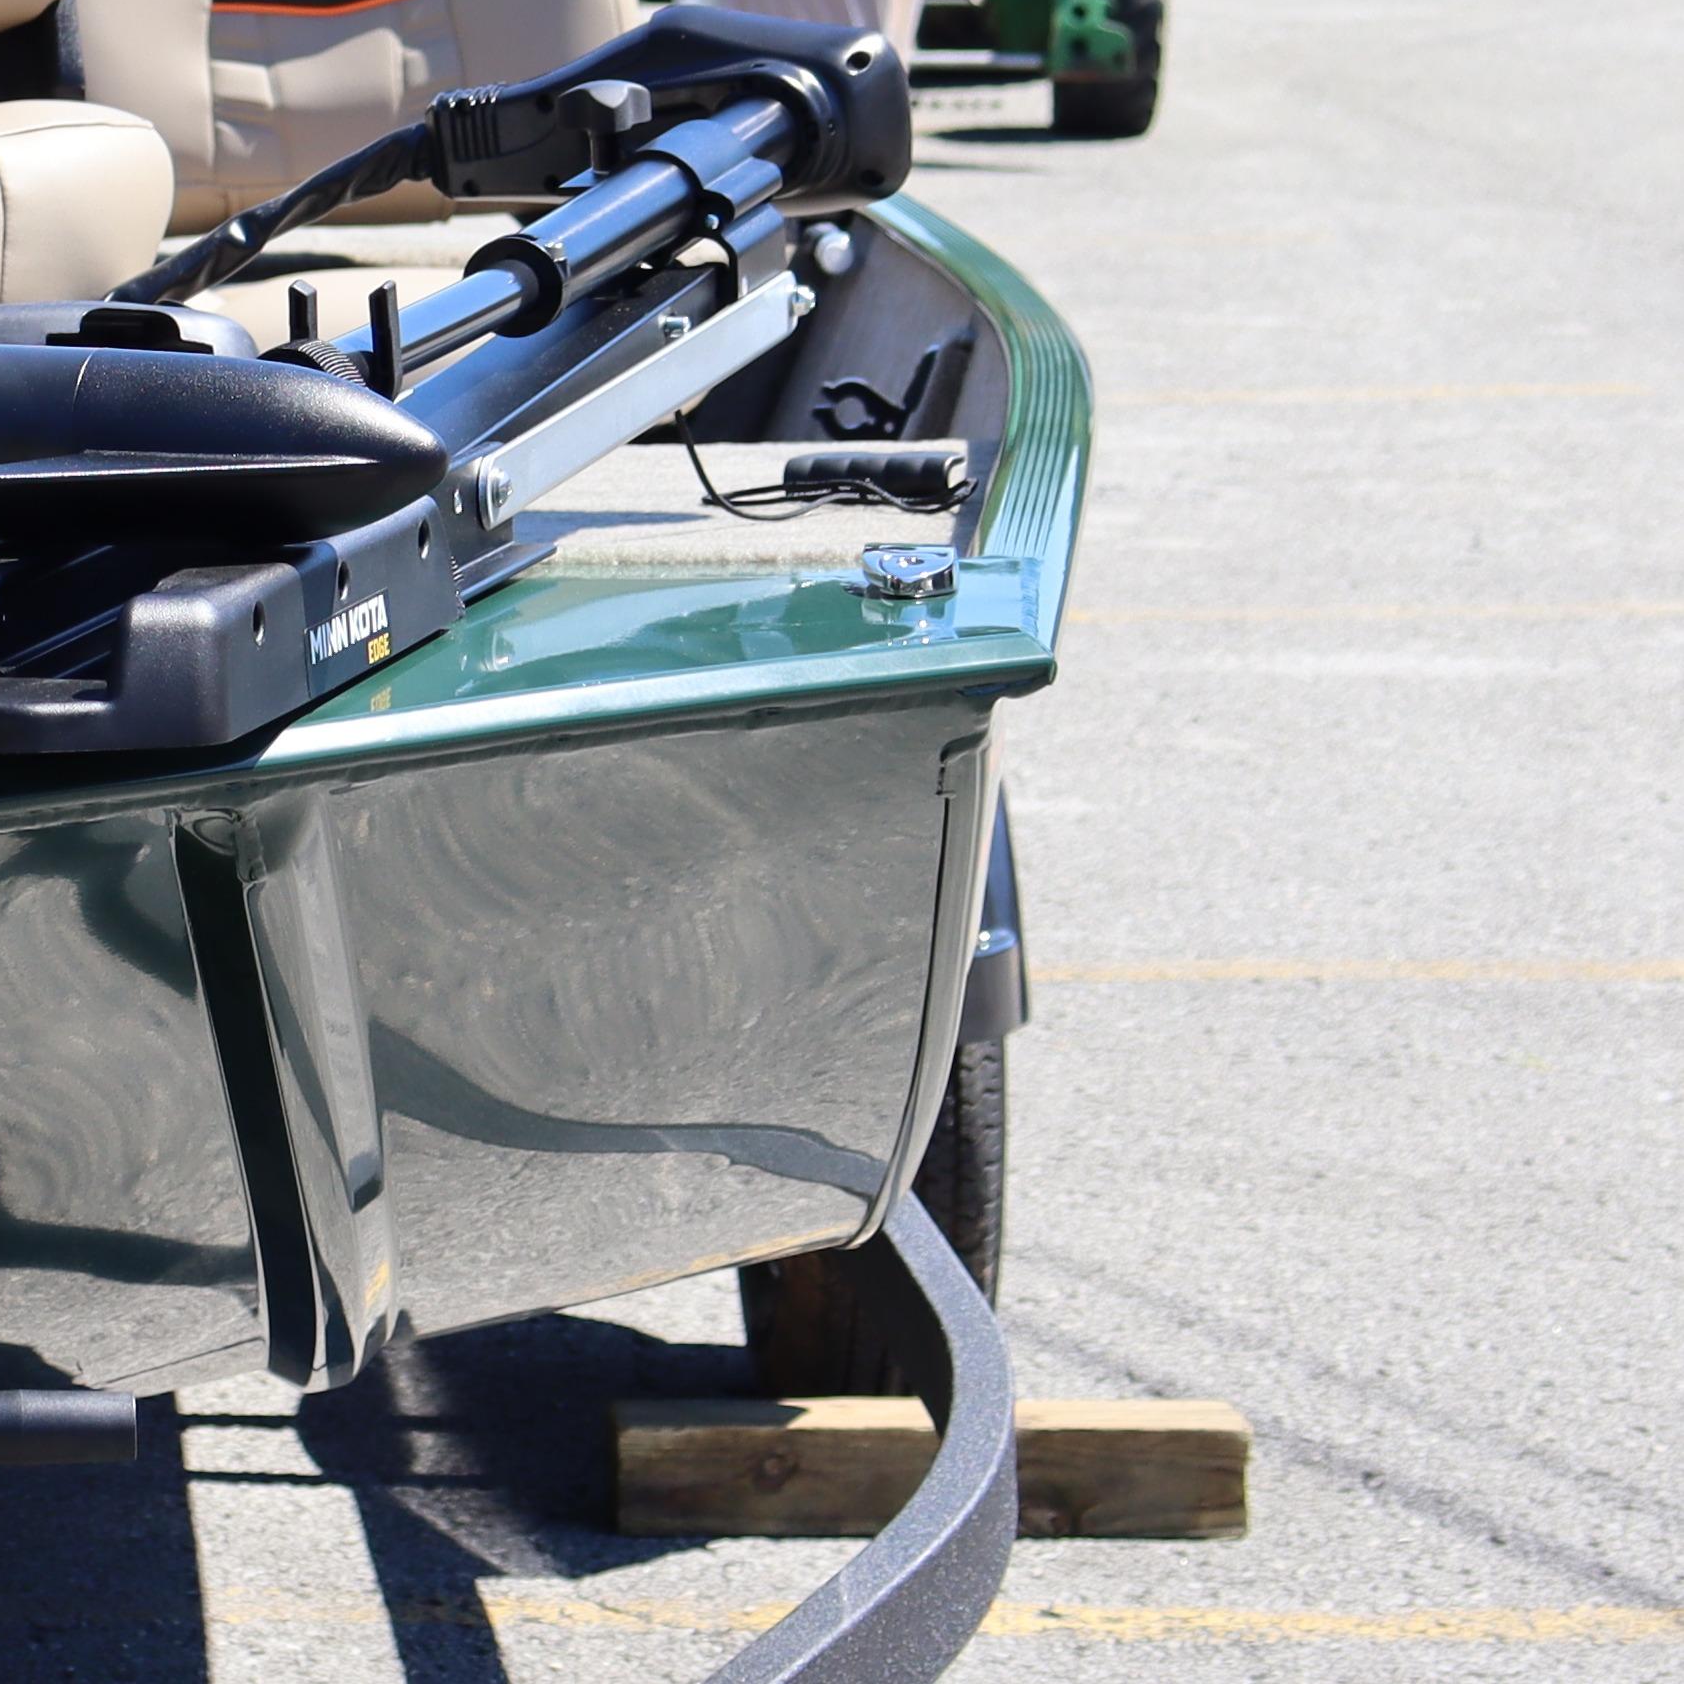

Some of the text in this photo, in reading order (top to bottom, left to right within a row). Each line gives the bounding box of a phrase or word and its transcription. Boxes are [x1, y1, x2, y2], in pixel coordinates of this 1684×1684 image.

[309, 594, 389, 665] MINN KOTA
[368, 632, 391, 665] EDGE
